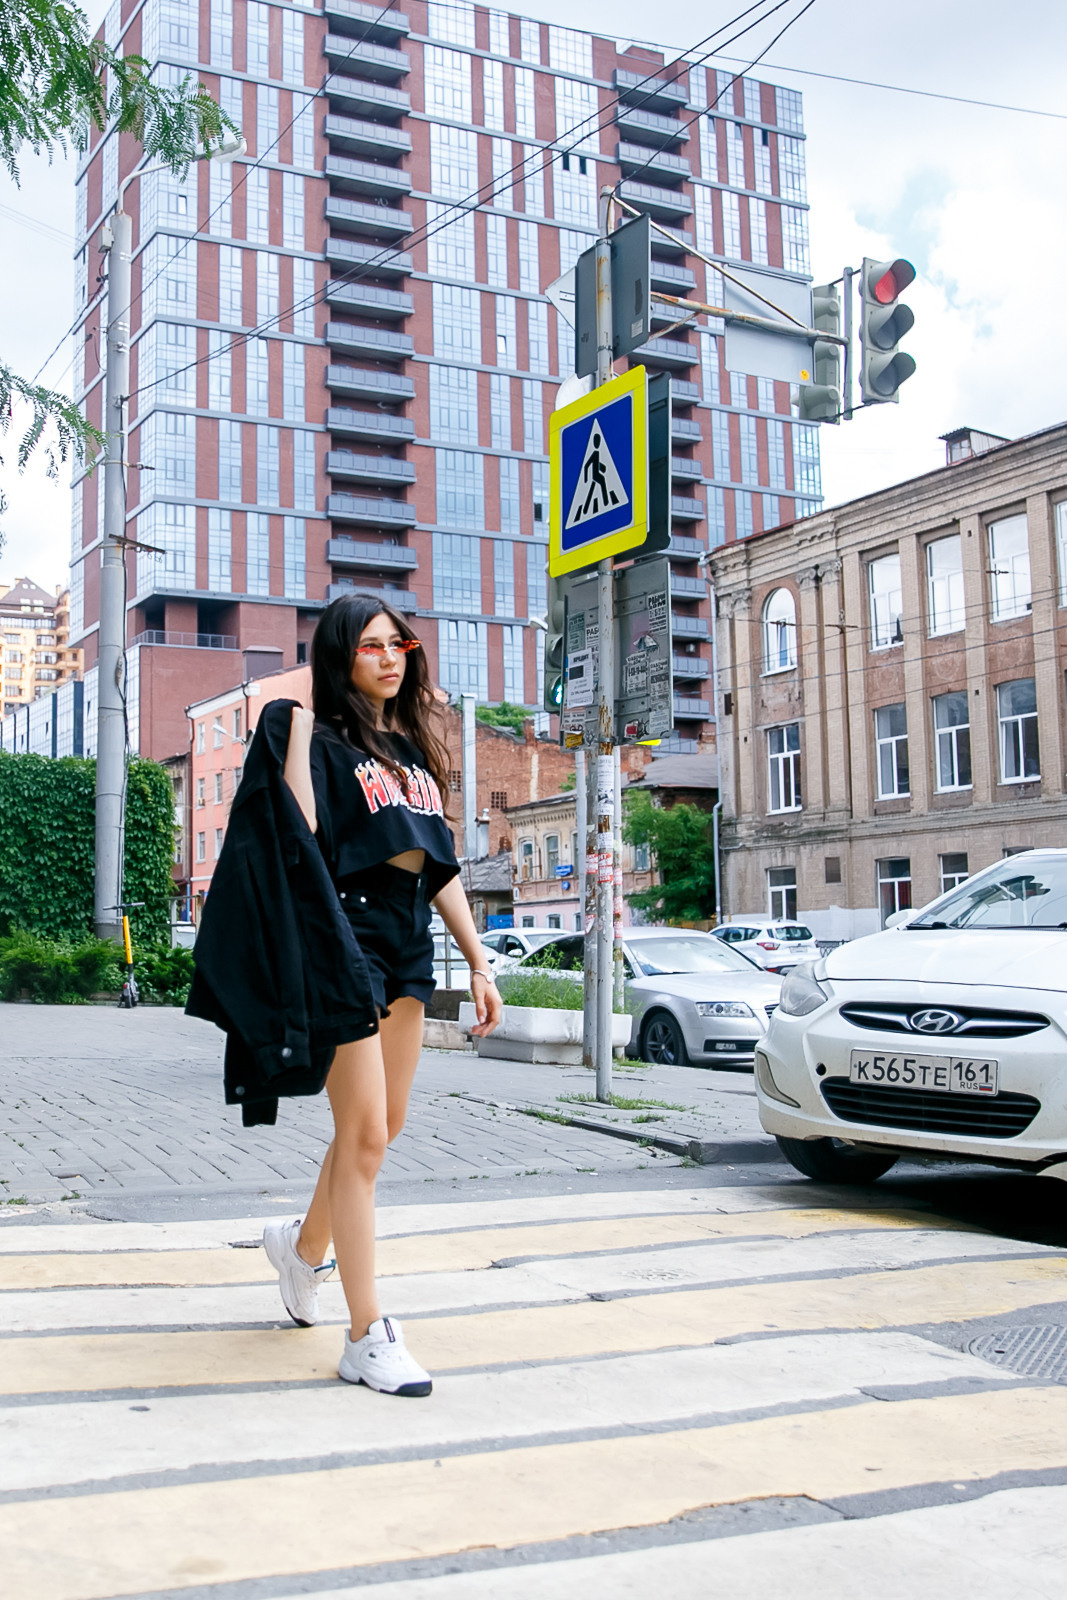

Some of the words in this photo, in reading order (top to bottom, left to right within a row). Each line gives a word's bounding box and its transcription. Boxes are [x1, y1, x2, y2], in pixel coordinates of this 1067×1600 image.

[857, 1056, 947, 1087] К565ТЕ
[953, 1062, 990, 1083] 161
[960, 1082, 978, 1090] RUS
